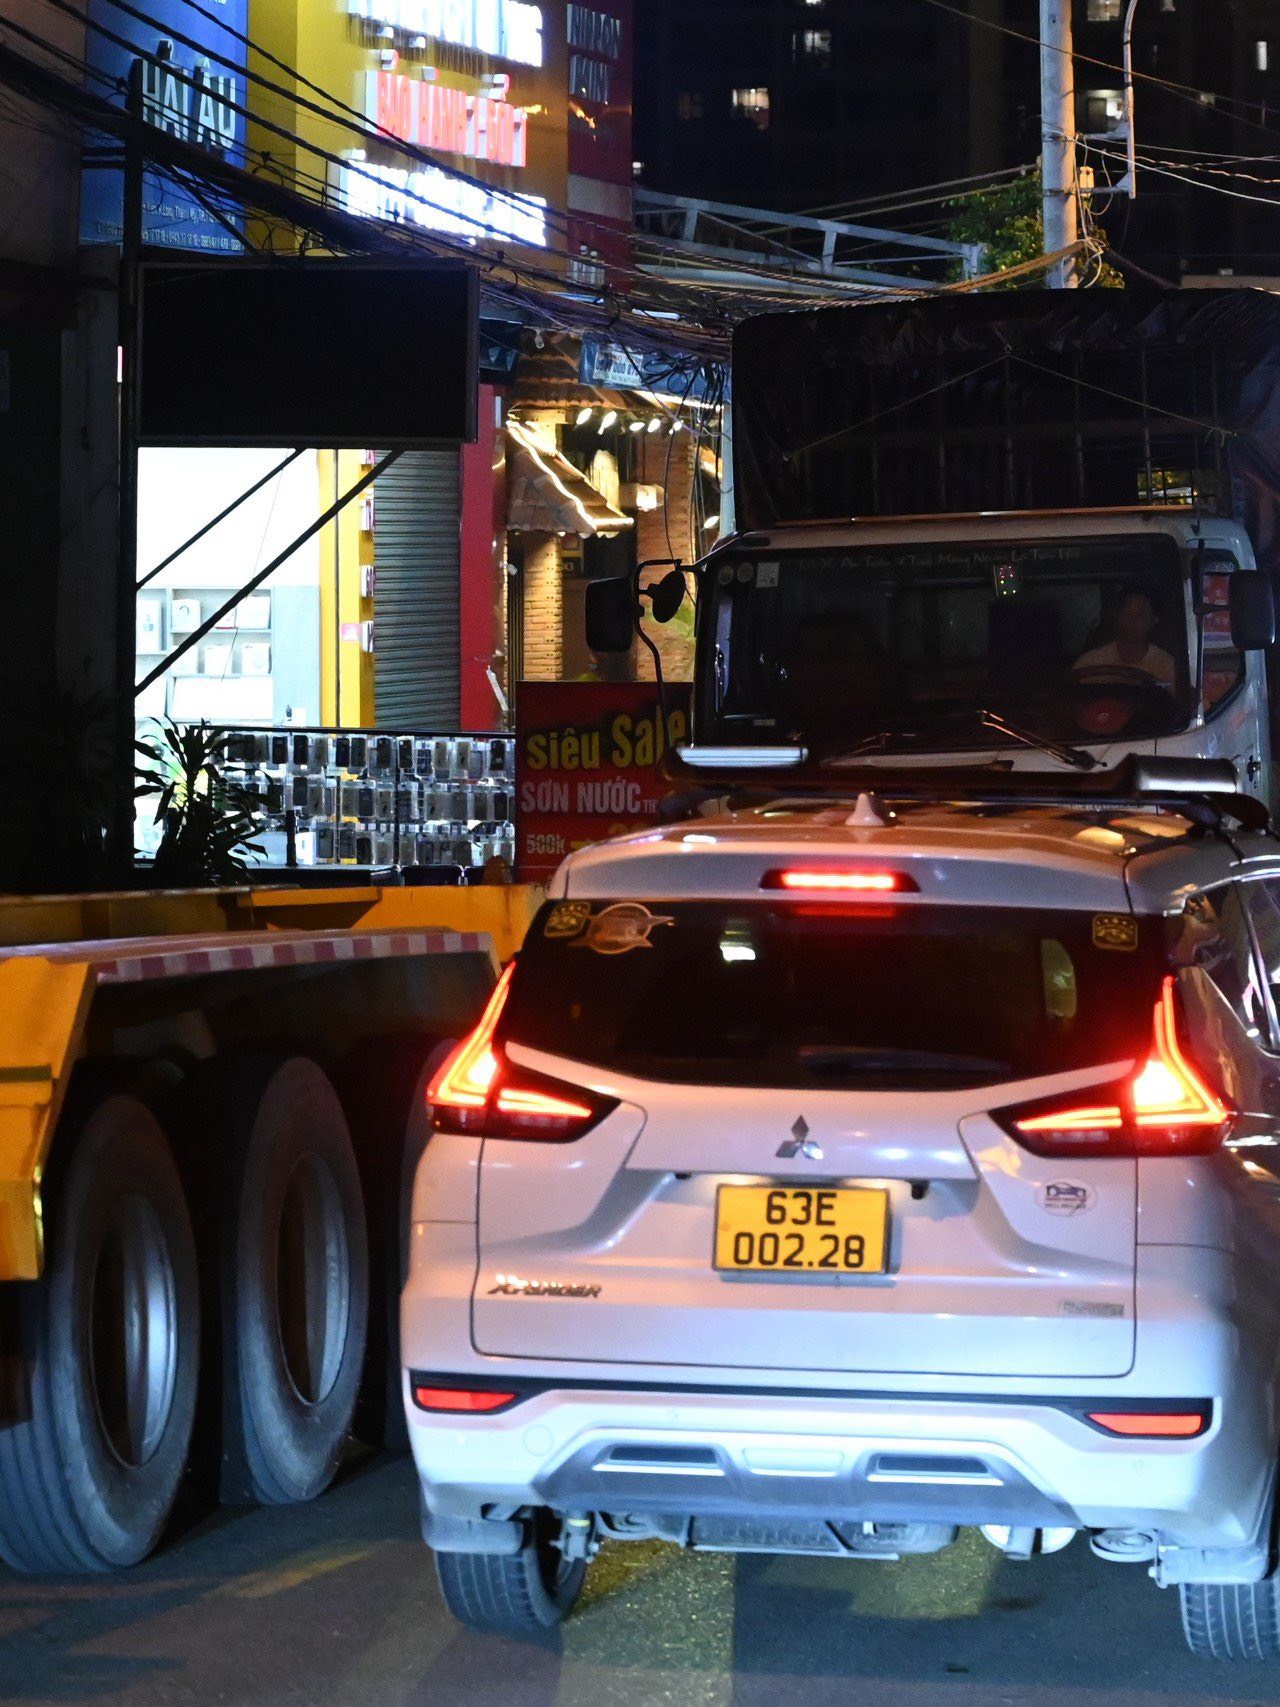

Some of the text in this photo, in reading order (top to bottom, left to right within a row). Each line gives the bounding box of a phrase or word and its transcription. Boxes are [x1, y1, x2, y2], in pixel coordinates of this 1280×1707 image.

[197, 57, 236, 148] ÂU
[612, 704, 686, 768] Sale
[521, 779, 569, 813] SƠN
[577, 775, 641, 814] NƯỚC
[766, 1191, 837, 1226] 63E
[734, 1232, 865, 1268] 002.28
